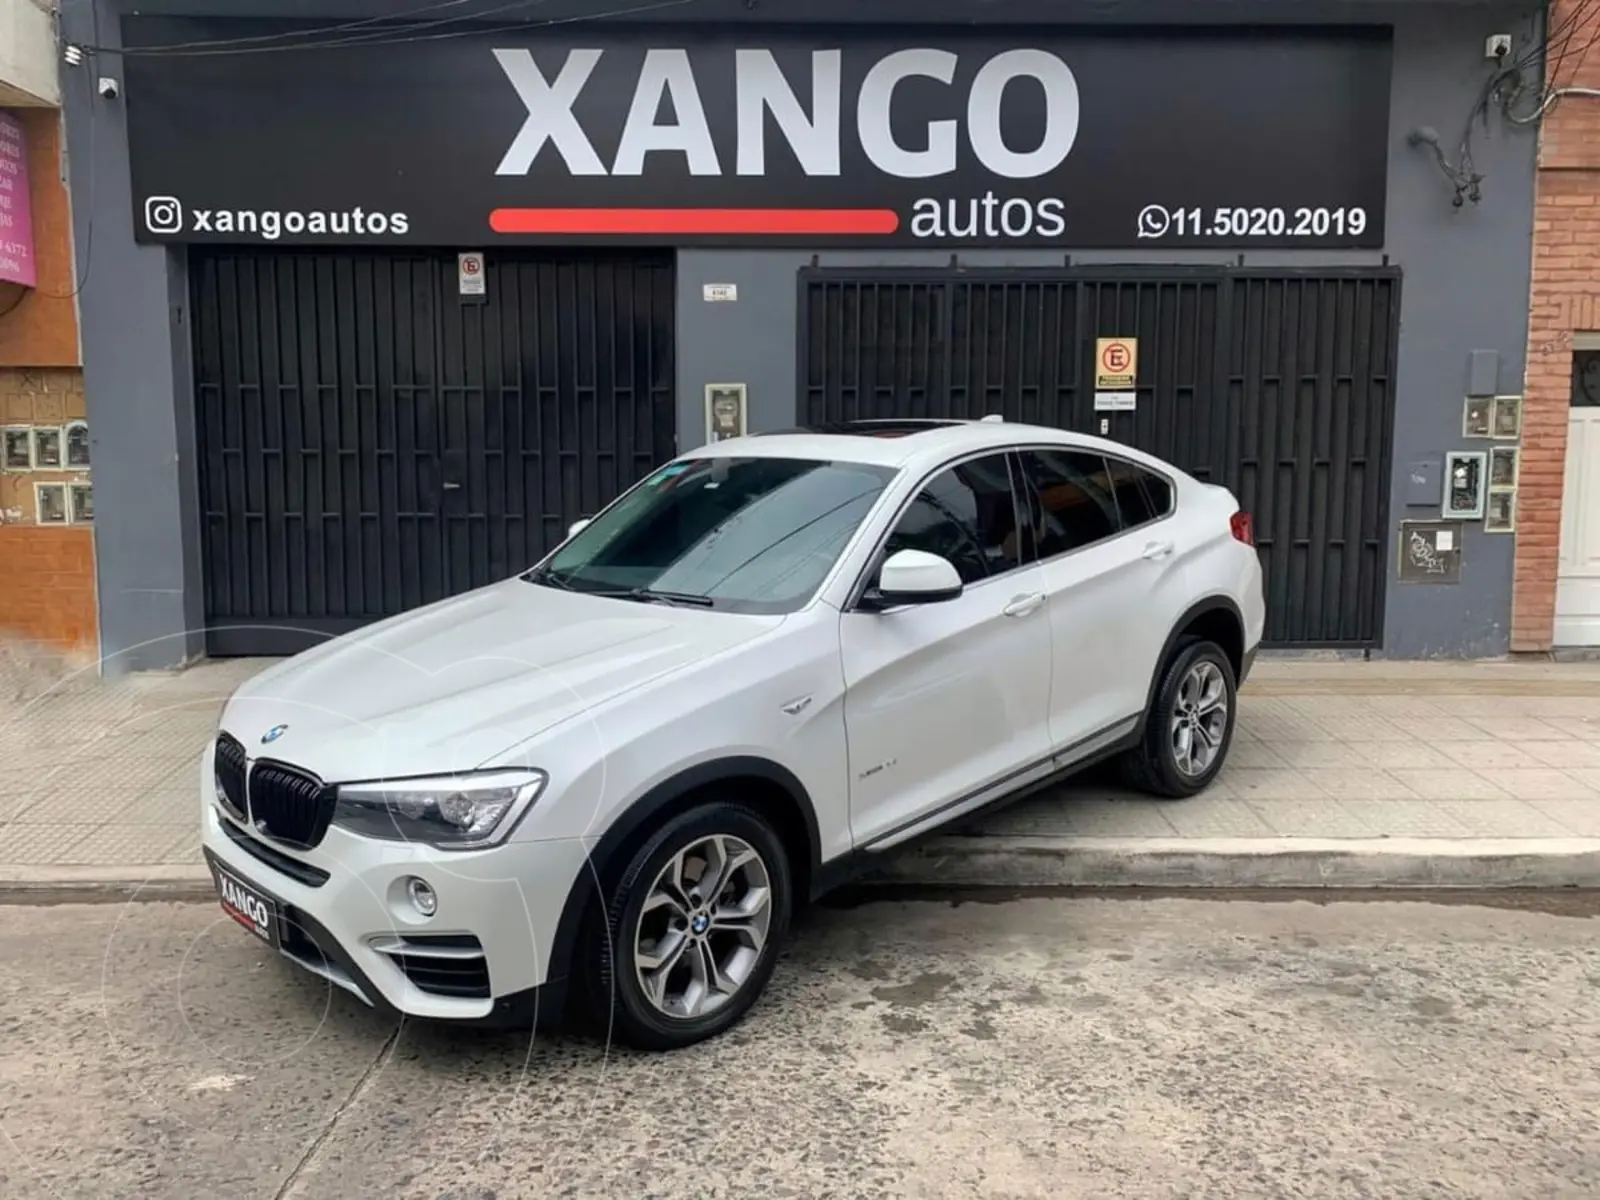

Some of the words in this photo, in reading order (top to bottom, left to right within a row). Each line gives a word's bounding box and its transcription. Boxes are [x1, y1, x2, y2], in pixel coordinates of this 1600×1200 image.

[492, 48, 1080, 179] XANGO
[192, 206, 410, 240] xangoautos
[911, 191, 1066, 238] autos
[1171, 206, 1367, 236] 11.5020.2019
[219, 873, 269, 928] XANGO
